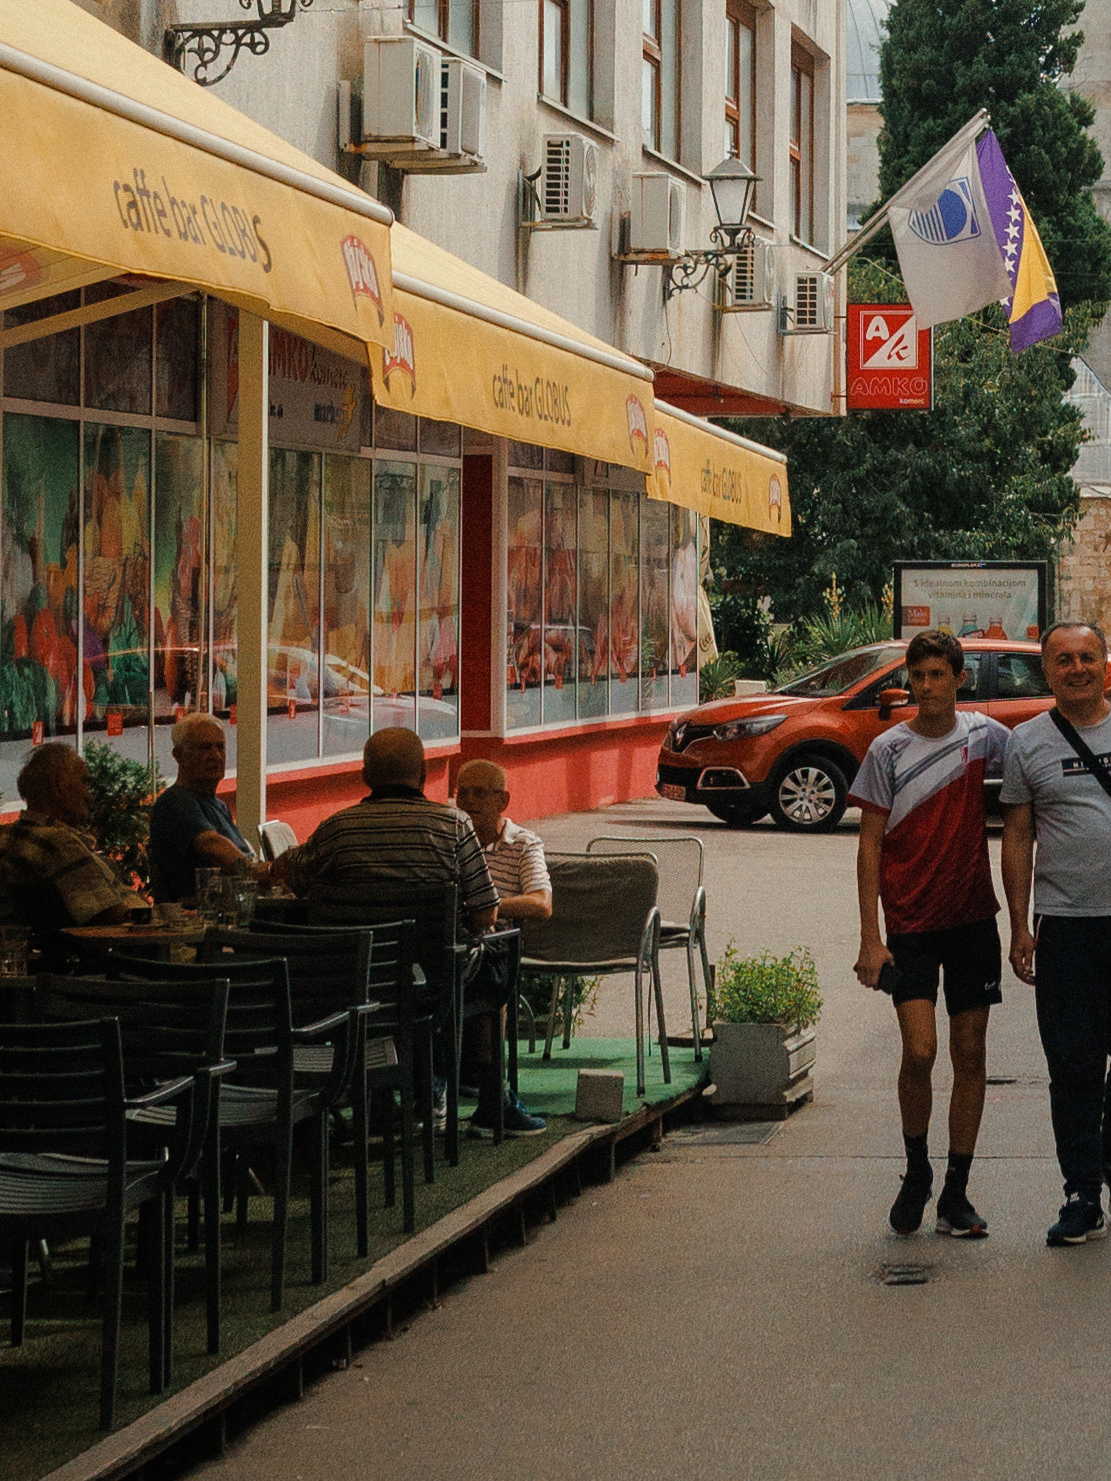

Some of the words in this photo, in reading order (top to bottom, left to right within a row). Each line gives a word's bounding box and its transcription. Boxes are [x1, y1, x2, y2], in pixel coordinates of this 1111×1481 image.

[161, 175, 206, 246] bar
[492, 363, 516, 412] caffe
[515, 369, 534, 418] bar
[534, 376, 572, 427] GLOBUS
[849, 376, 928, 396] AMKO
